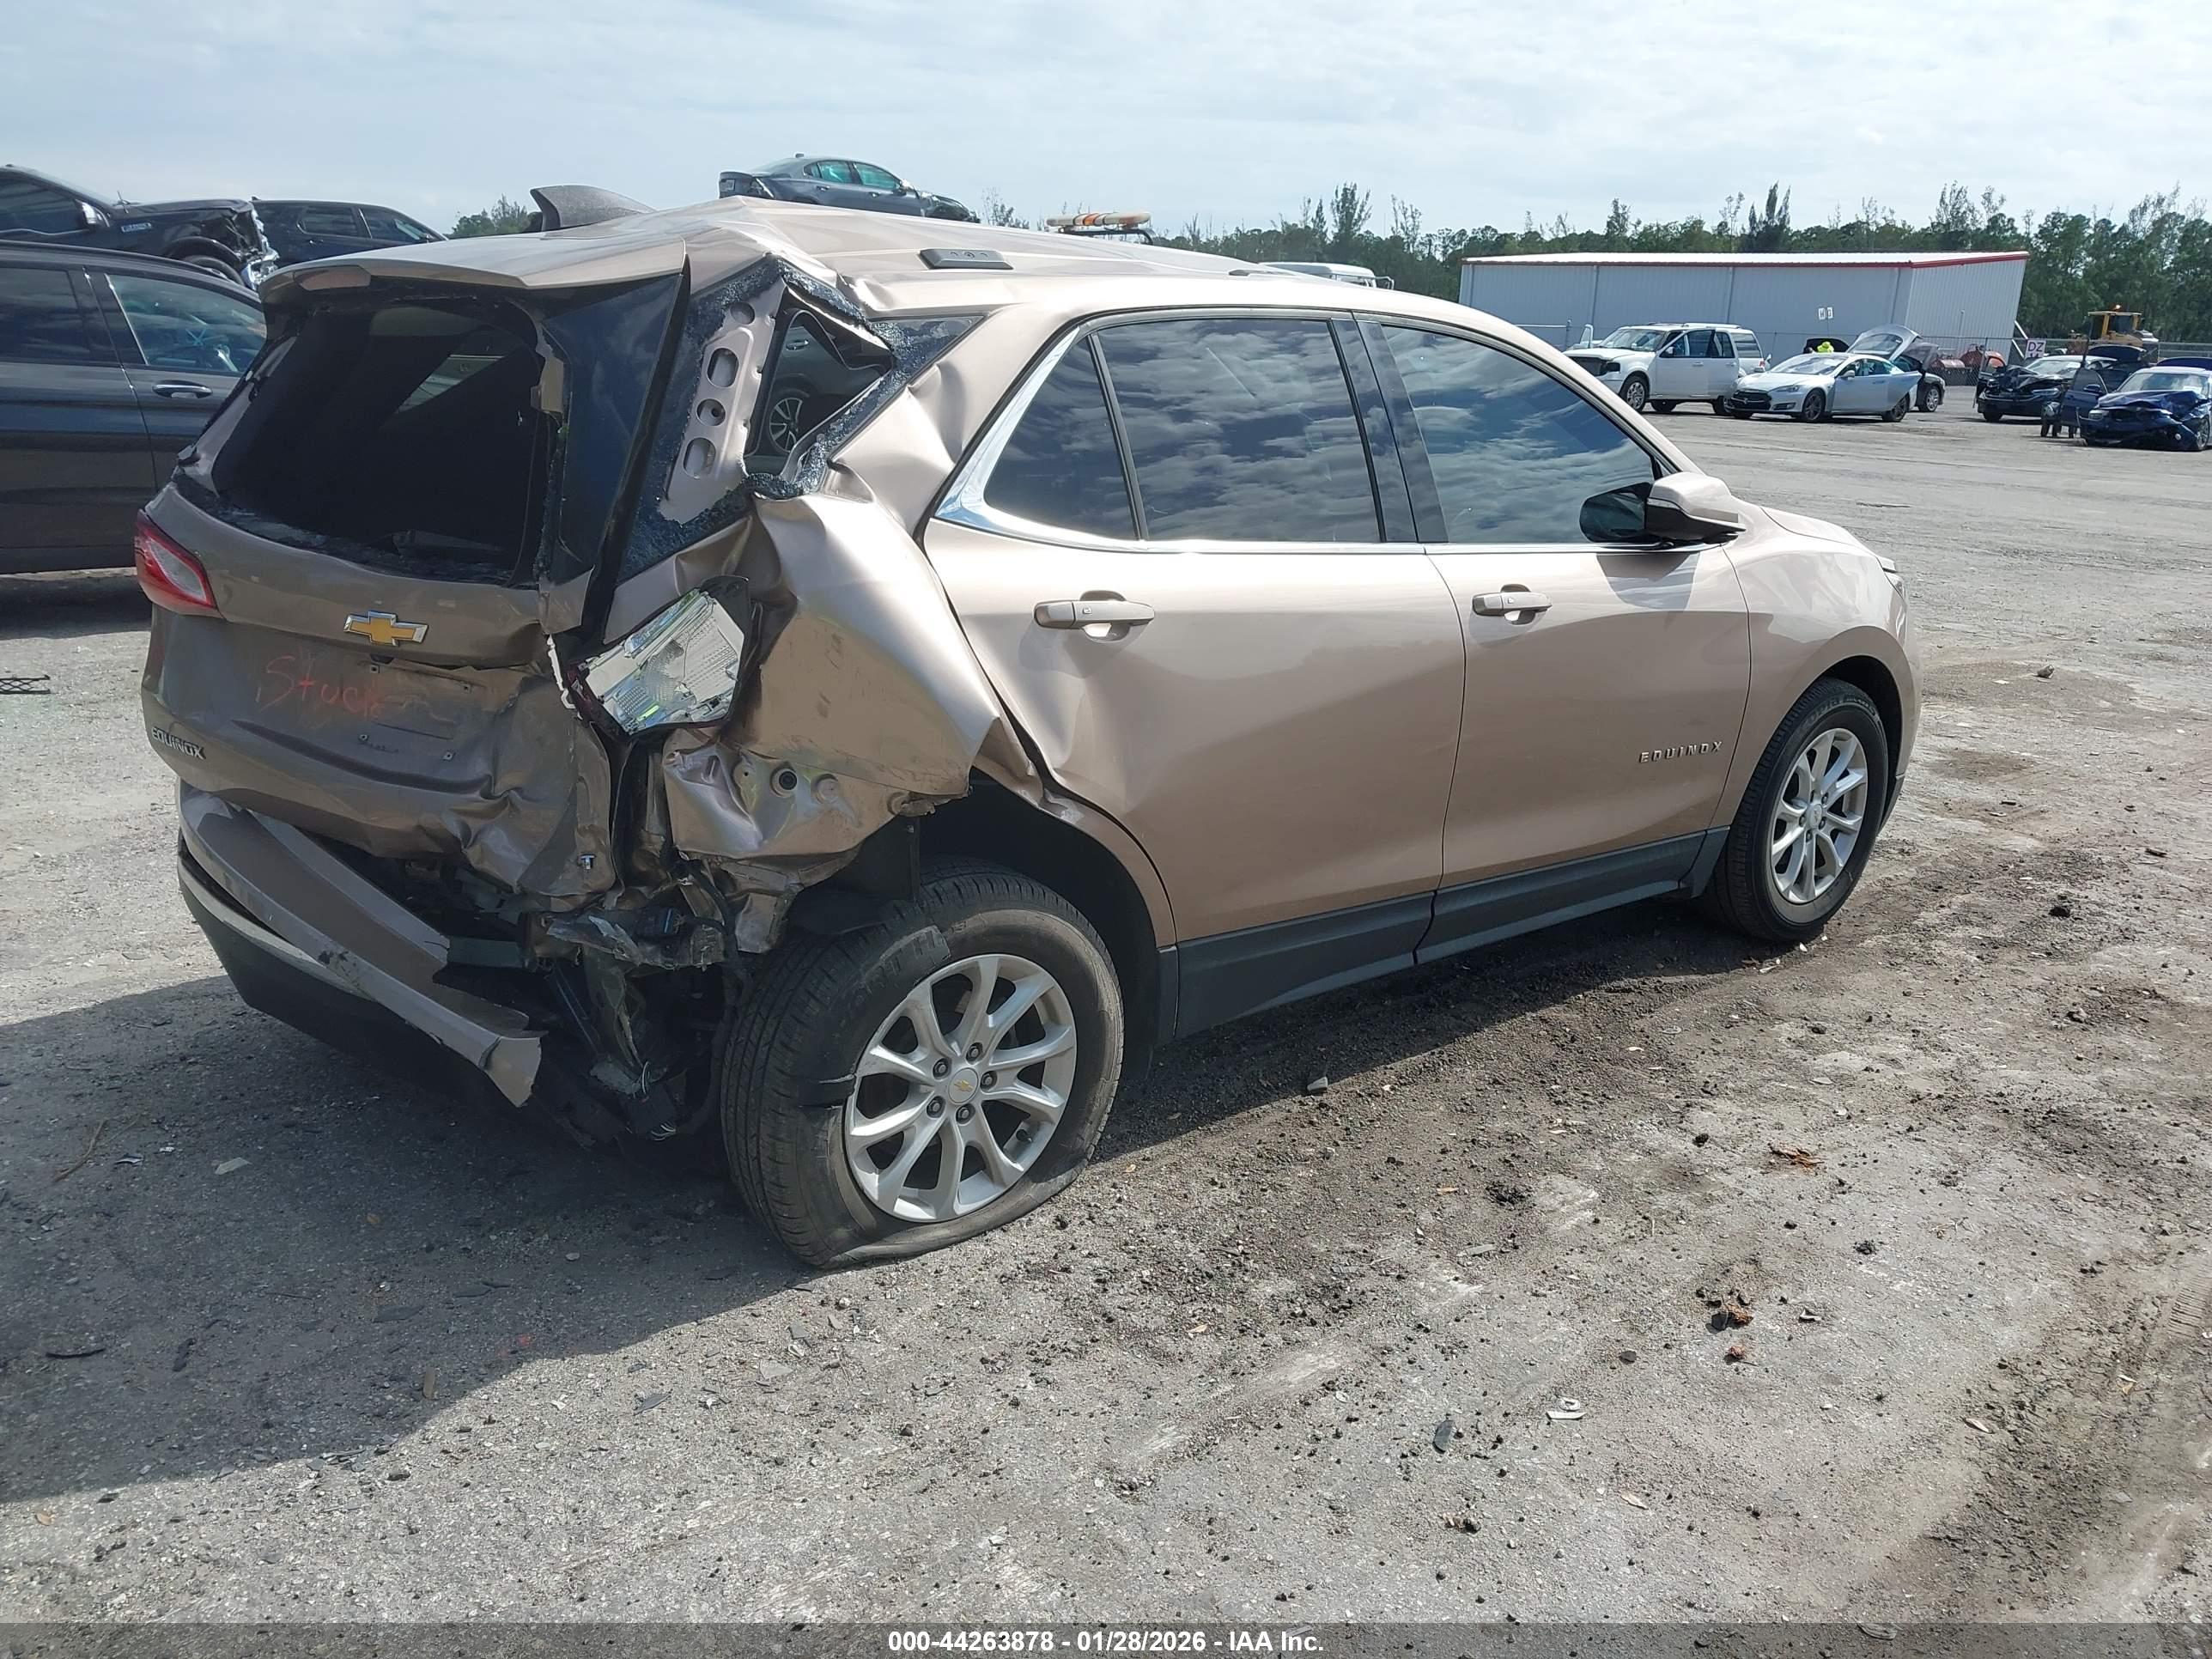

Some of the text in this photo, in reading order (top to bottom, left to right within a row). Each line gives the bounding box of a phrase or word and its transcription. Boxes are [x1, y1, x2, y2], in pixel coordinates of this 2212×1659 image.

[2027, 342, 2045, 352] DZ
[151, 726, 205, 760] EQUINOX
[1638, 741, 1723, 763] EQUINOX
